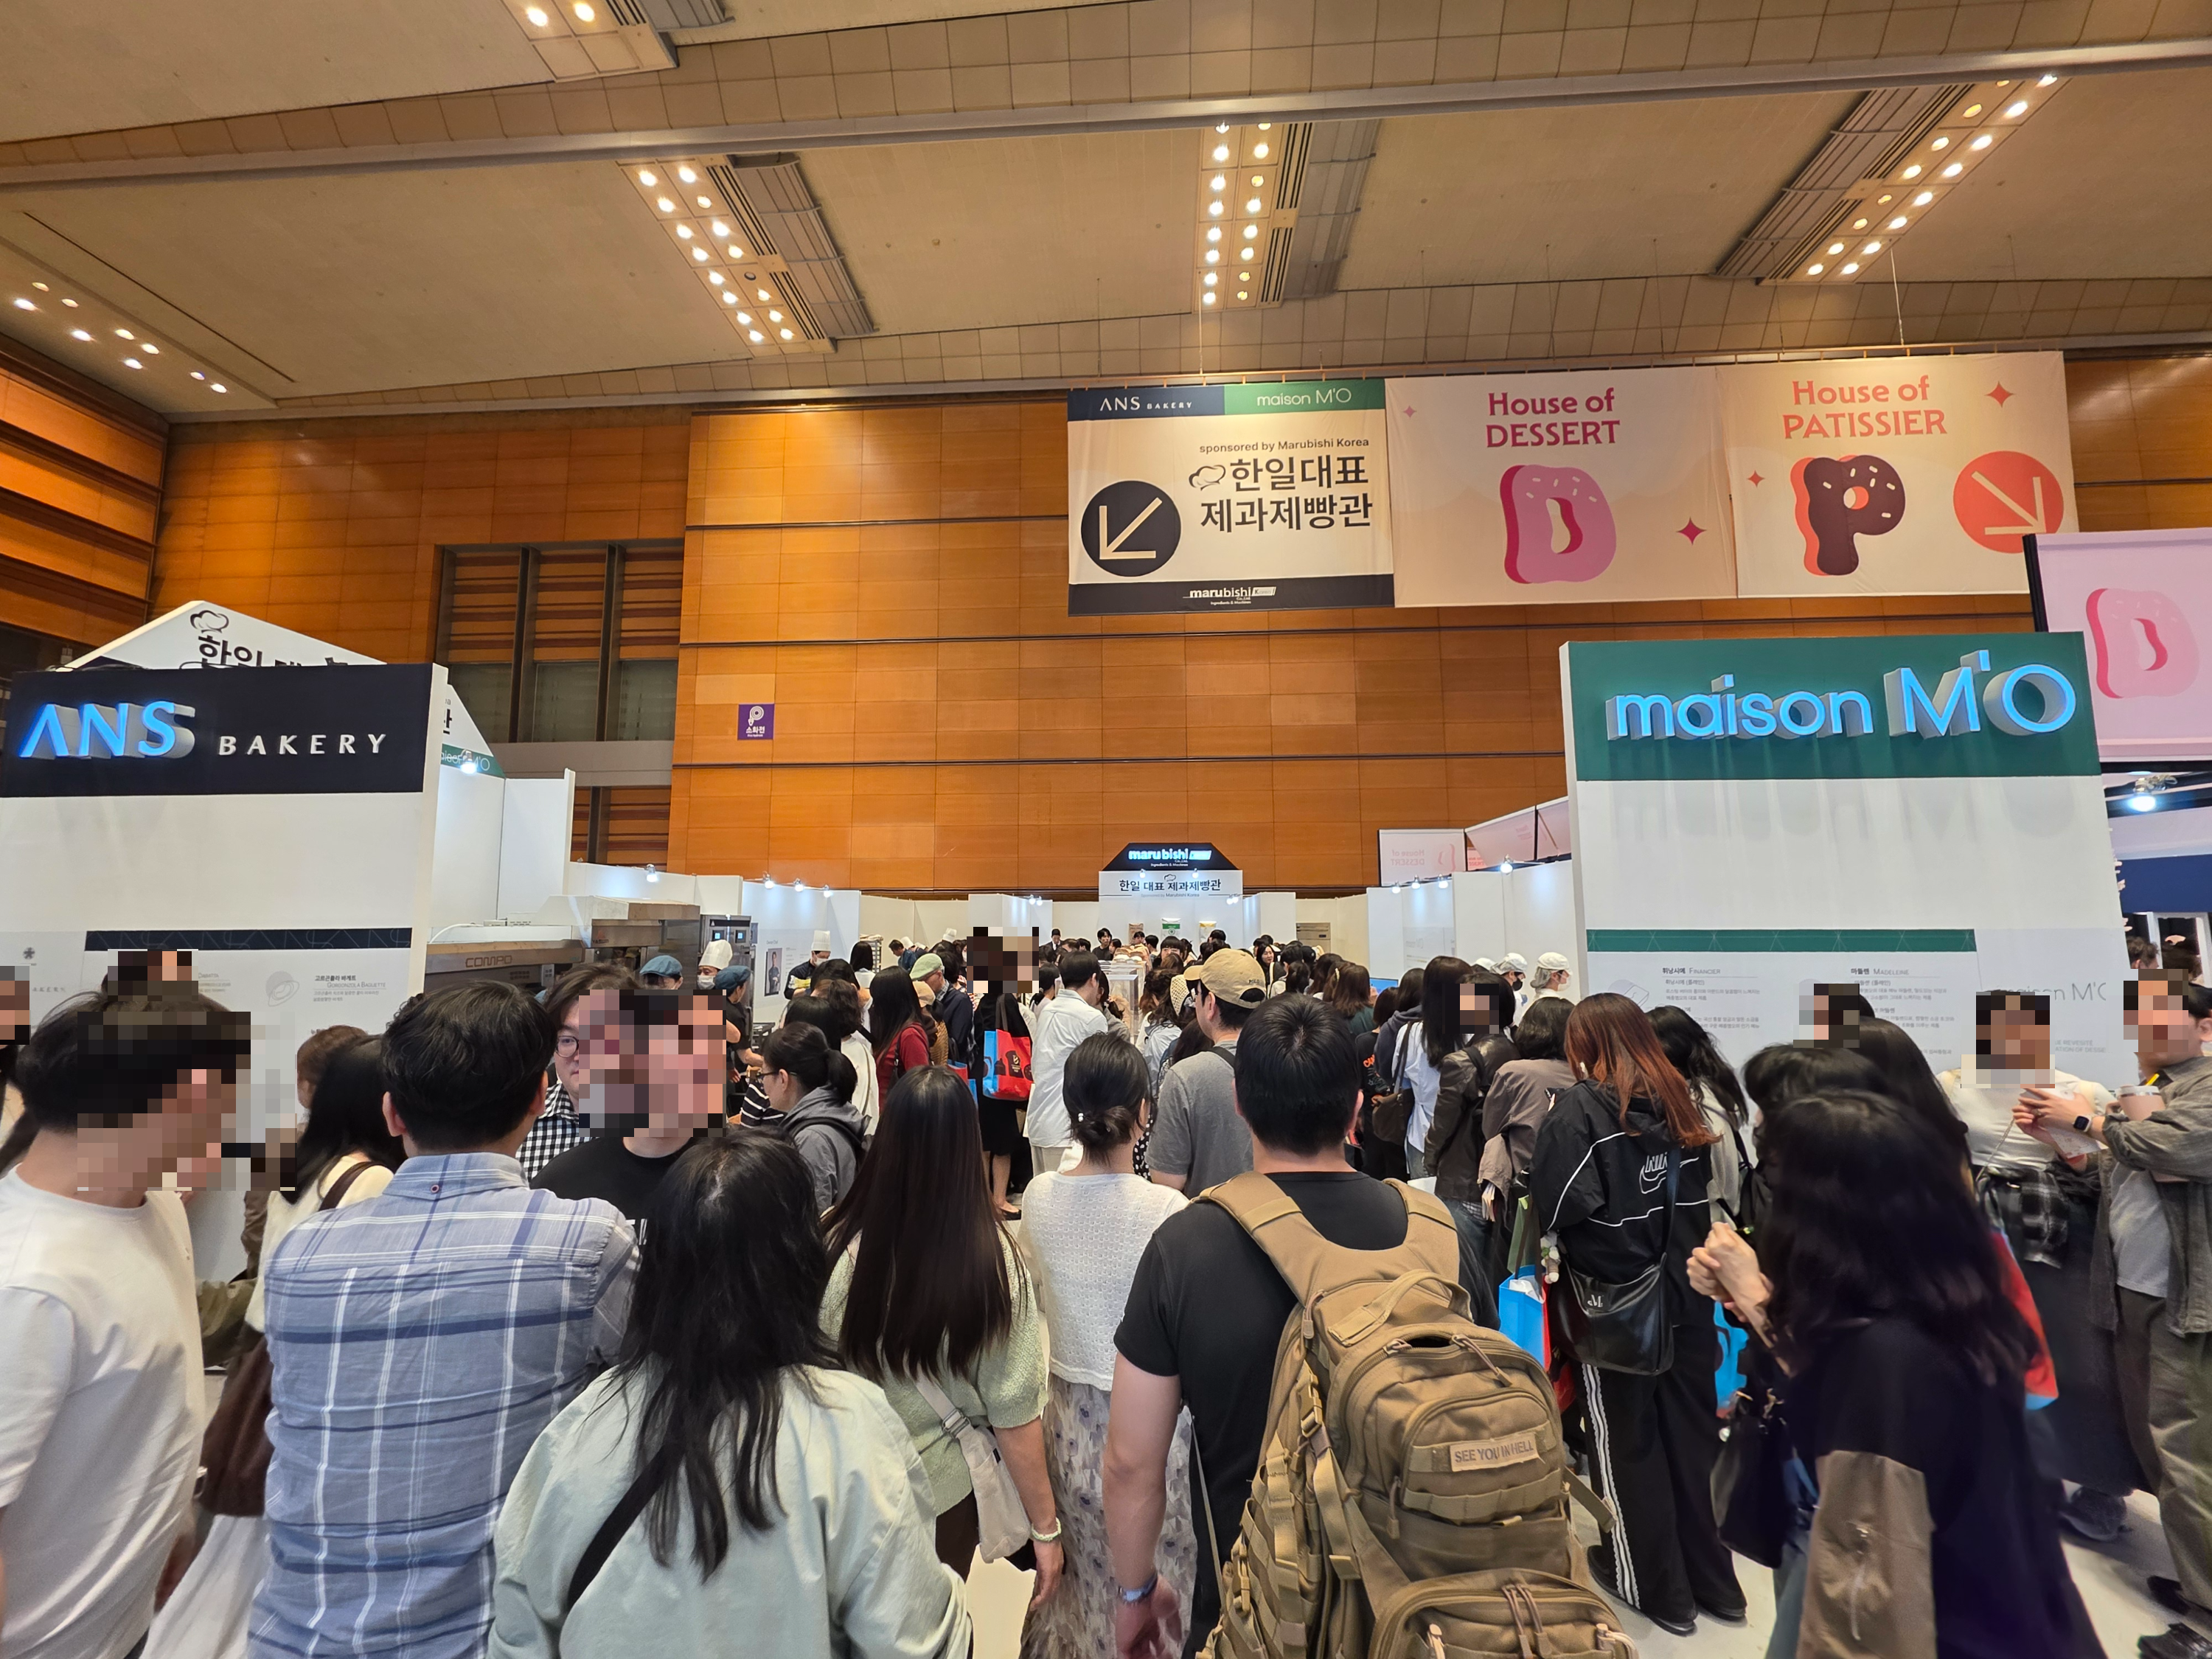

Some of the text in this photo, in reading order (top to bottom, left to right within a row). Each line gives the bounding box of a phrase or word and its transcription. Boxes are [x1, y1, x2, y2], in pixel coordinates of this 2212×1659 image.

[1256, 388, 1352, 406] maison M'O
[1488, 387, 1615, 416] House of
[1792, 375, 1930, 405] House of
[1099, 396, 1192, 411] ANS BAKERY
[1486, 420, 1621, 448] DESSERT
[1782, 409, 1948, 439] PATISSIER
[1199, 438, 1369, 453] sponsored by Marubishi Korea
[1229, 454, 1369, 493] 한일대표
[1200, 493, 1374, 533] 제과제빵관
[1189, 587, 1251, 598] marubishi
[1612, 650, 2077, 738] maison M'O
[19, 700, 387, 758] ANS BAKERY
[1128, 848, 1189, 860] marubishi
[1119, 879, 1222, 891] 한일 대표 제과제빵관
[465, 955, 512, 967] COMPO
[1454, 1439, 1534, 1463] SEE YOU IN HELL
